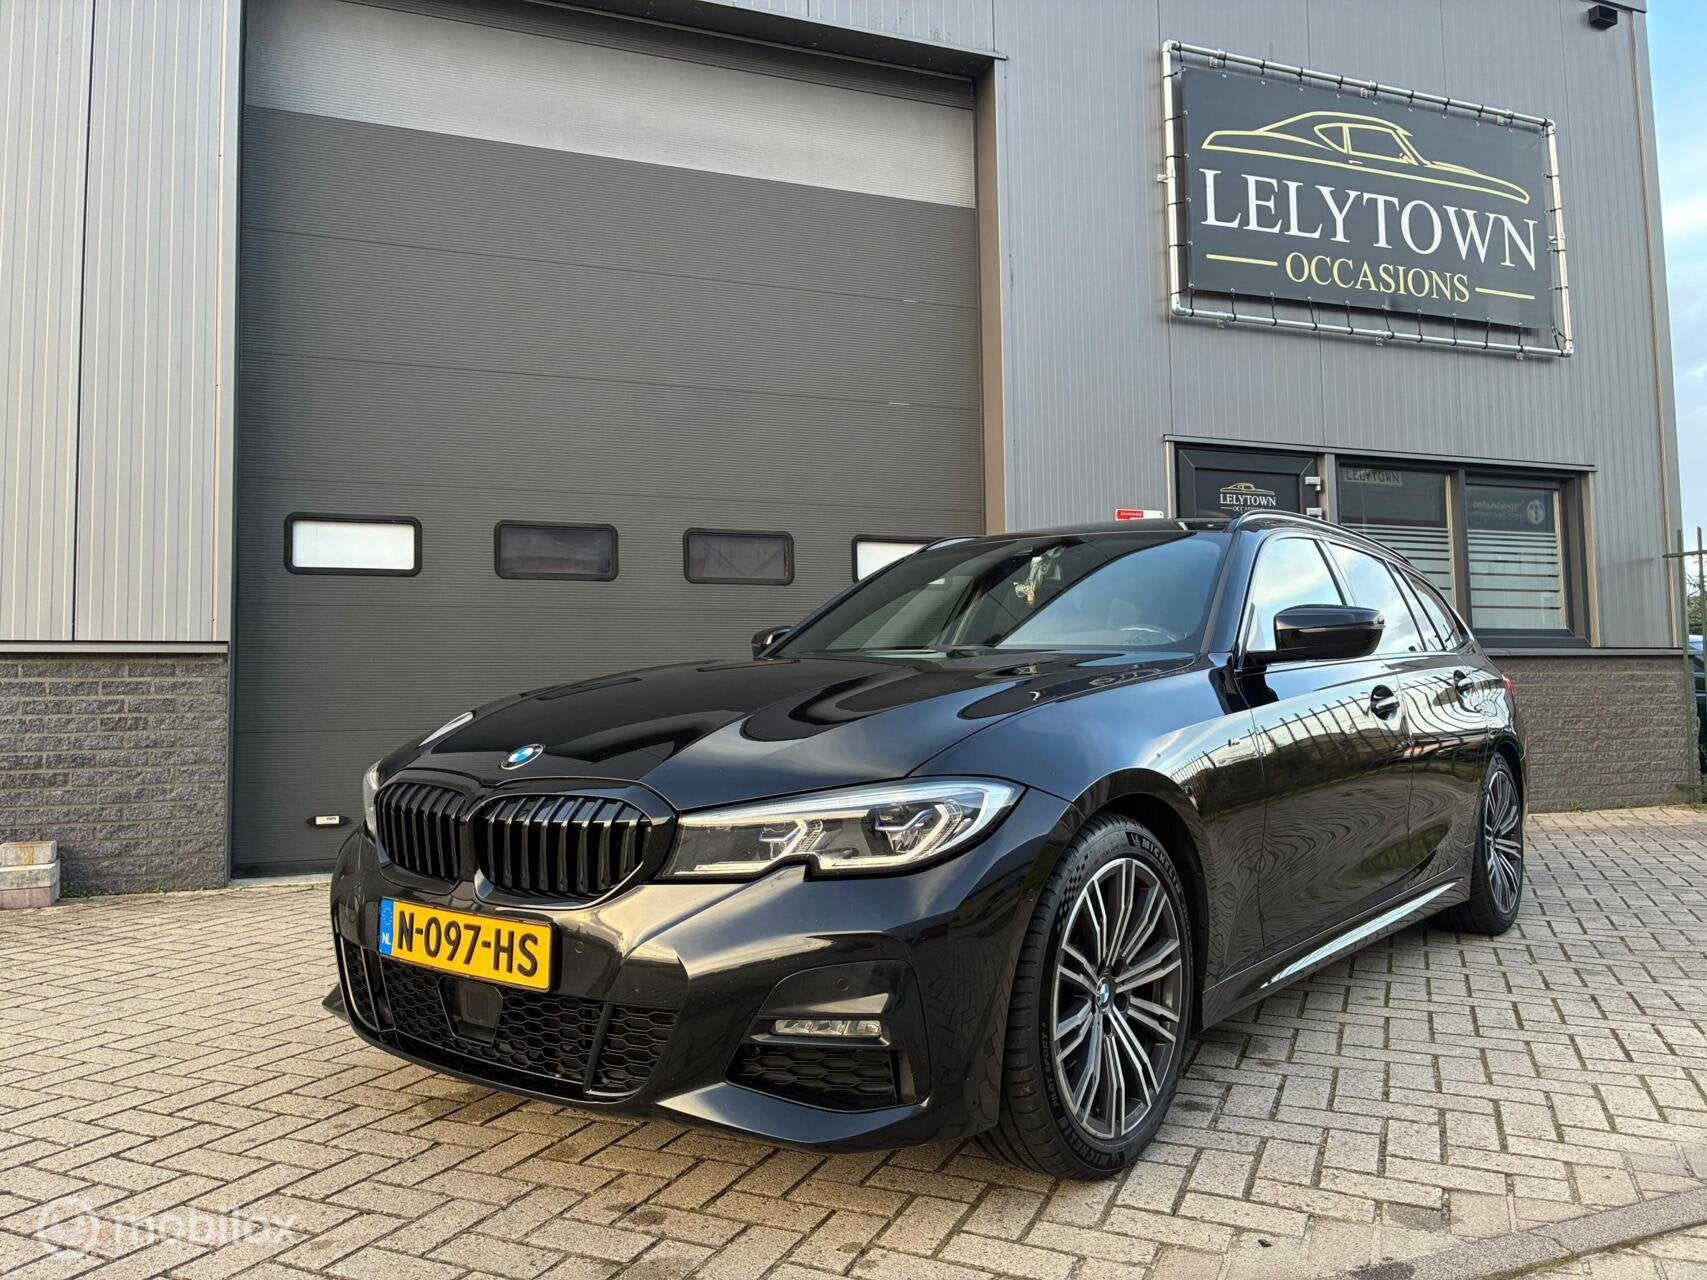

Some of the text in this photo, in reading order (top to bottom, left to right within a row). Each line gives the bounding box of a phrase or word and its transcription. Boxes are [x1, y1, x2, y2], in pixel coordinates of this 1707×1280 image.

[1199, 168, 1538, 271] LELYTOWN
[1285, 252, 1470, 303] OCCASIONS
[1346, 470, 1400, 484] LELYTOWN
[1219, 493, 1277, 507] LELYTOWN
[381, 931, 392, 946] NL
[397, 910, 539, 978] N-097-HS
